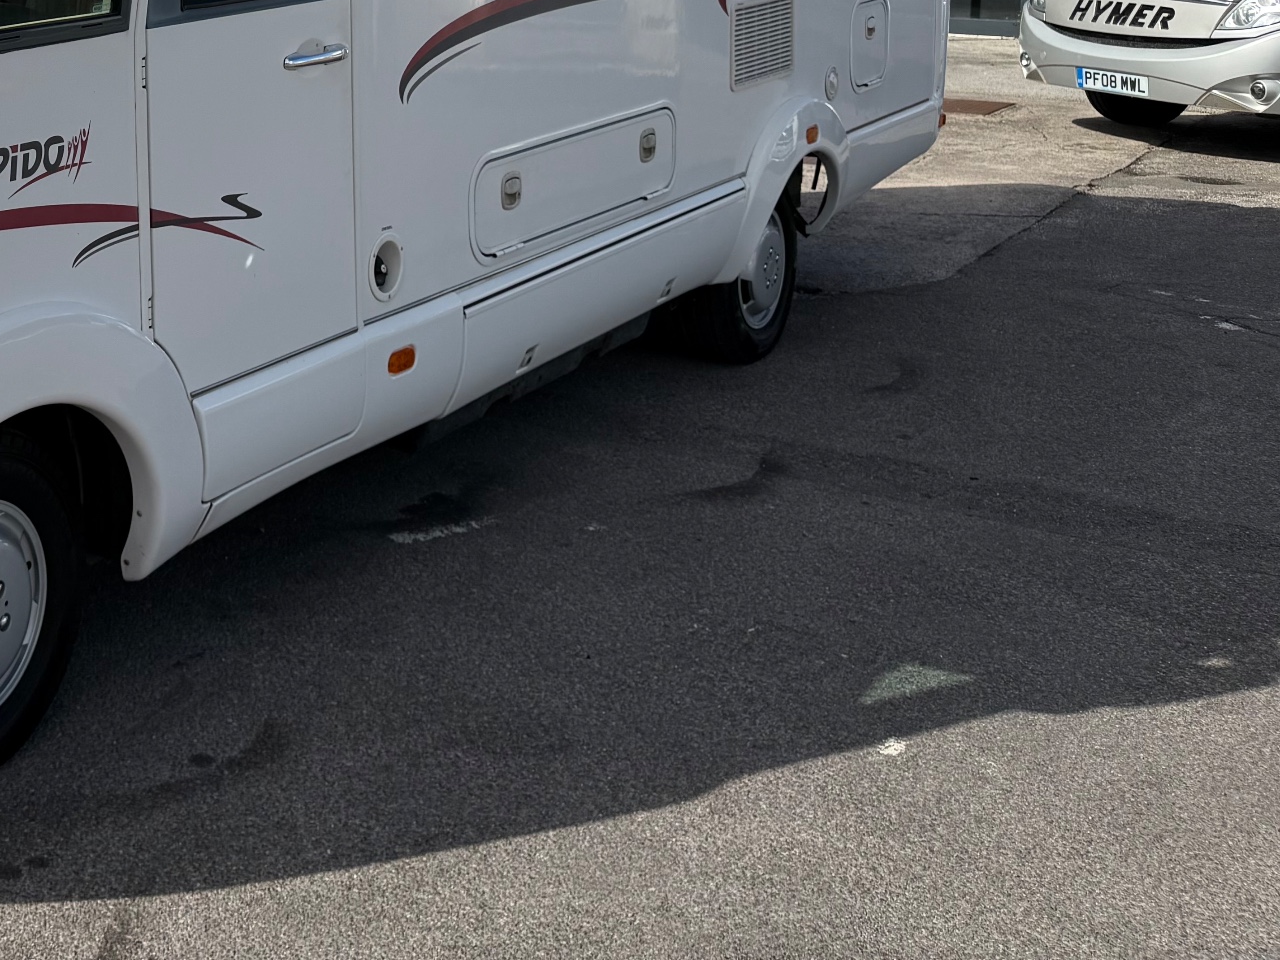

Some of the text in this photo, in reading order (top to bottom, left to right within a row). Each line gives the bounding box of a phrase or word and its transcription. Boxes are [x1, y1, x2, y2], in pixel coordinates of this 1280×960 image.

[1068, 0, 1176, 30] HYMER
[1085, 71, 1146, 94] PF08 MWL
